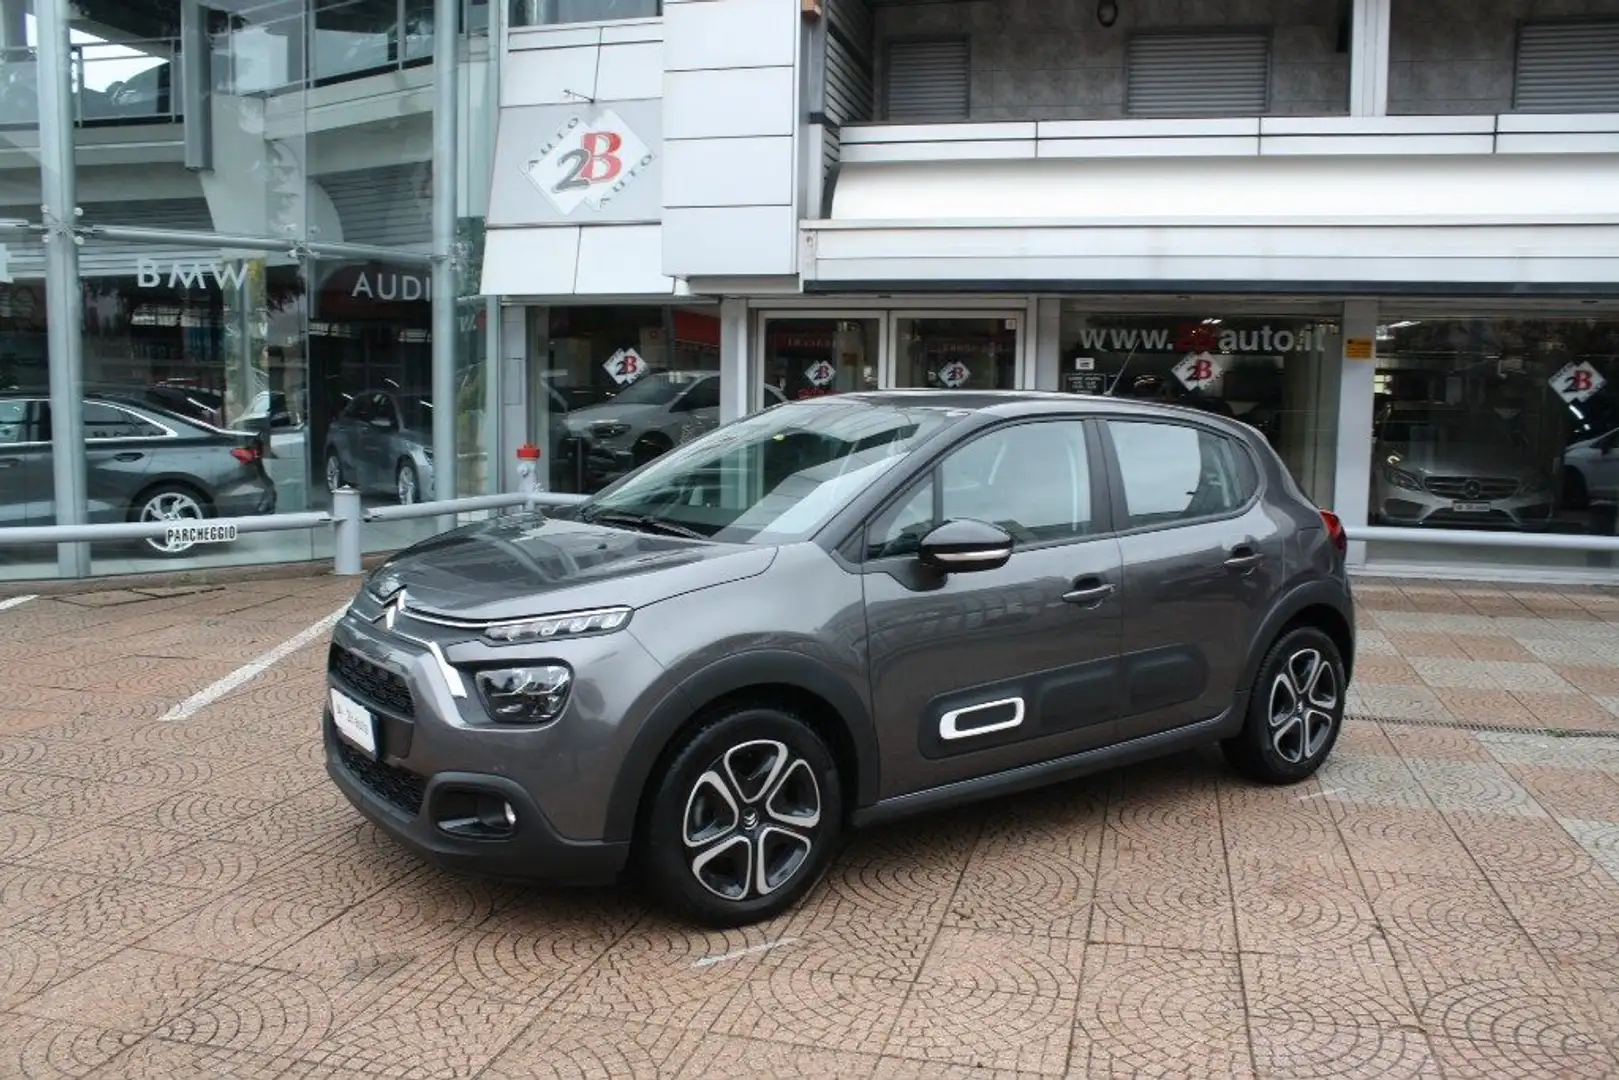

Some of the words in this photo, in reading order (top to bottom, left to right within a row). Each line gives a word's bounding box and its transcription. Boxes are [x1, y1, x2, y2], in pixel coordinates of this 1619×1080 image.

[551, 131, 622, 194] 2B
[137, 257, 249, 290] BMW
[351, 271, 431, 302] AUDI
[615, 355, 638, 376] 2B
[1185, 358, 1213, 382] 2B
[1562, 369, 1593, 394] 2B
[167, 525, 236, 542] PARCHEGGIO
